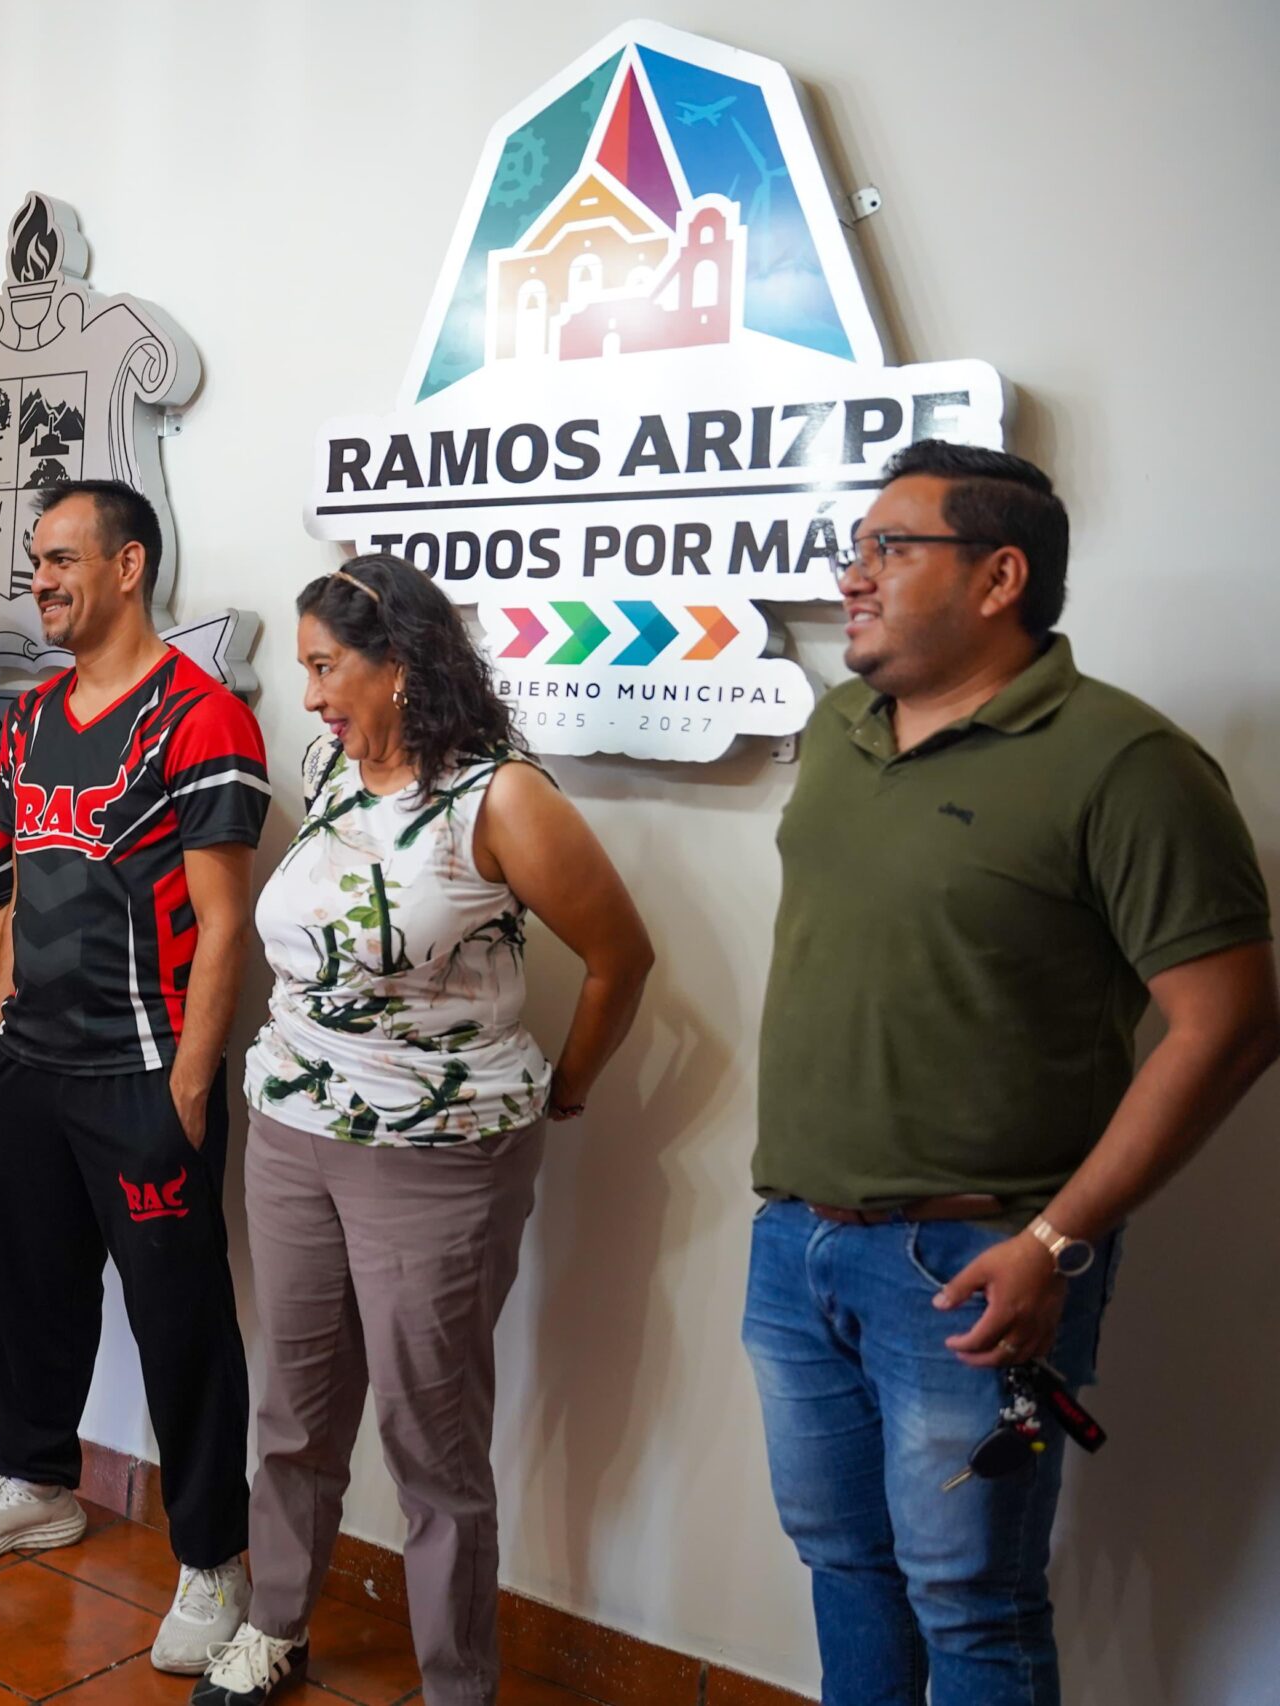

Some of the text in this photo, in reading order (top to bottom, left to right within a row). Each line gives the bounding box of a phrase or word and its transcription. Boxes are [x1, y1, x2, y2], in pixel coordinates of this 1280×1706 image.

[326, 390, 971, 493] RAMOS ARIZPE
[370, 500, 867, 581] TODOS POR MÁ
[499, 680, 786, 704] BIERNO MUNICIPAL
[519, 711, 586, 728] 2025
[639, 715, 712, 733] 2027
[14, 762, 128, 839] RAC
[118, 1165, 187, 1211] RAC
